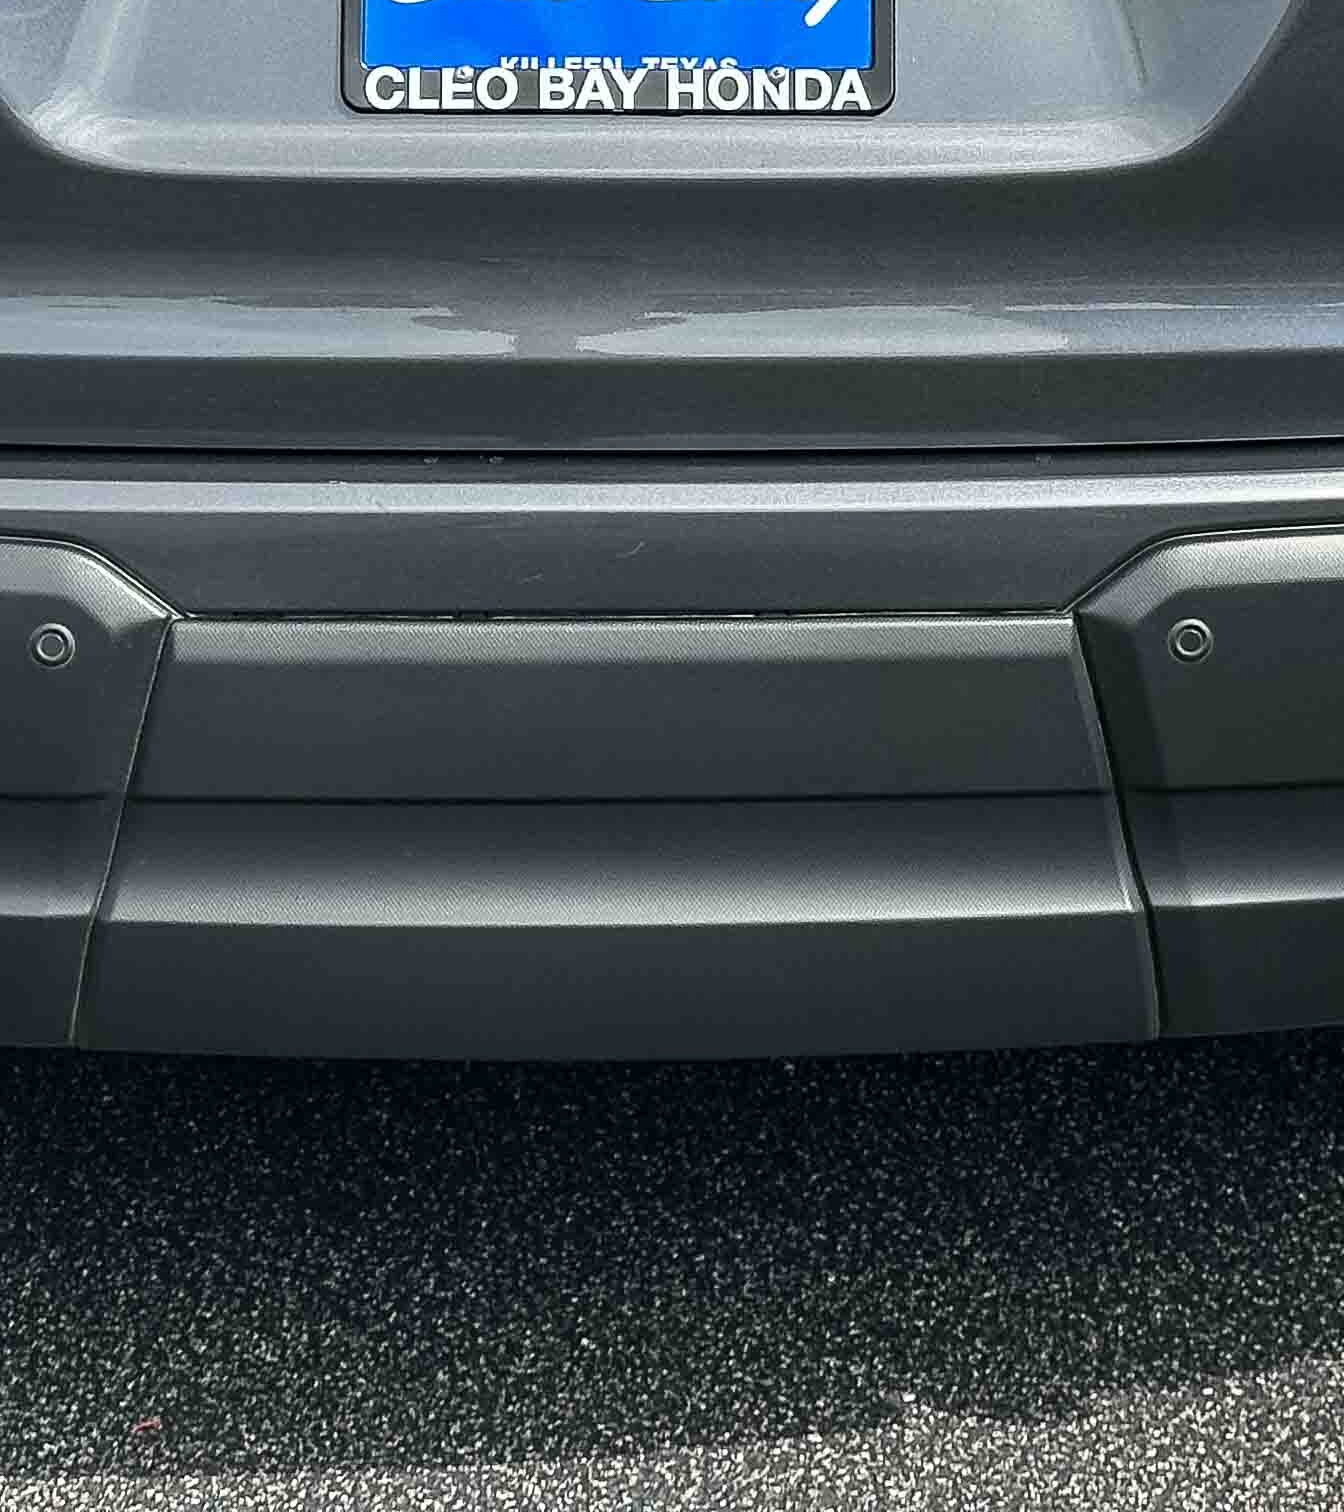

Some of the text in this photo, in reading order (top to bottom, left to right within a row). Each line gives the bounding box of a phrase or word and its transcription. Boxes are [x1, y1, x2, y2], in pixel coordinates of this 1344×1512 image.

[364, 66, 872, 112] CLEO BAY HONDA
